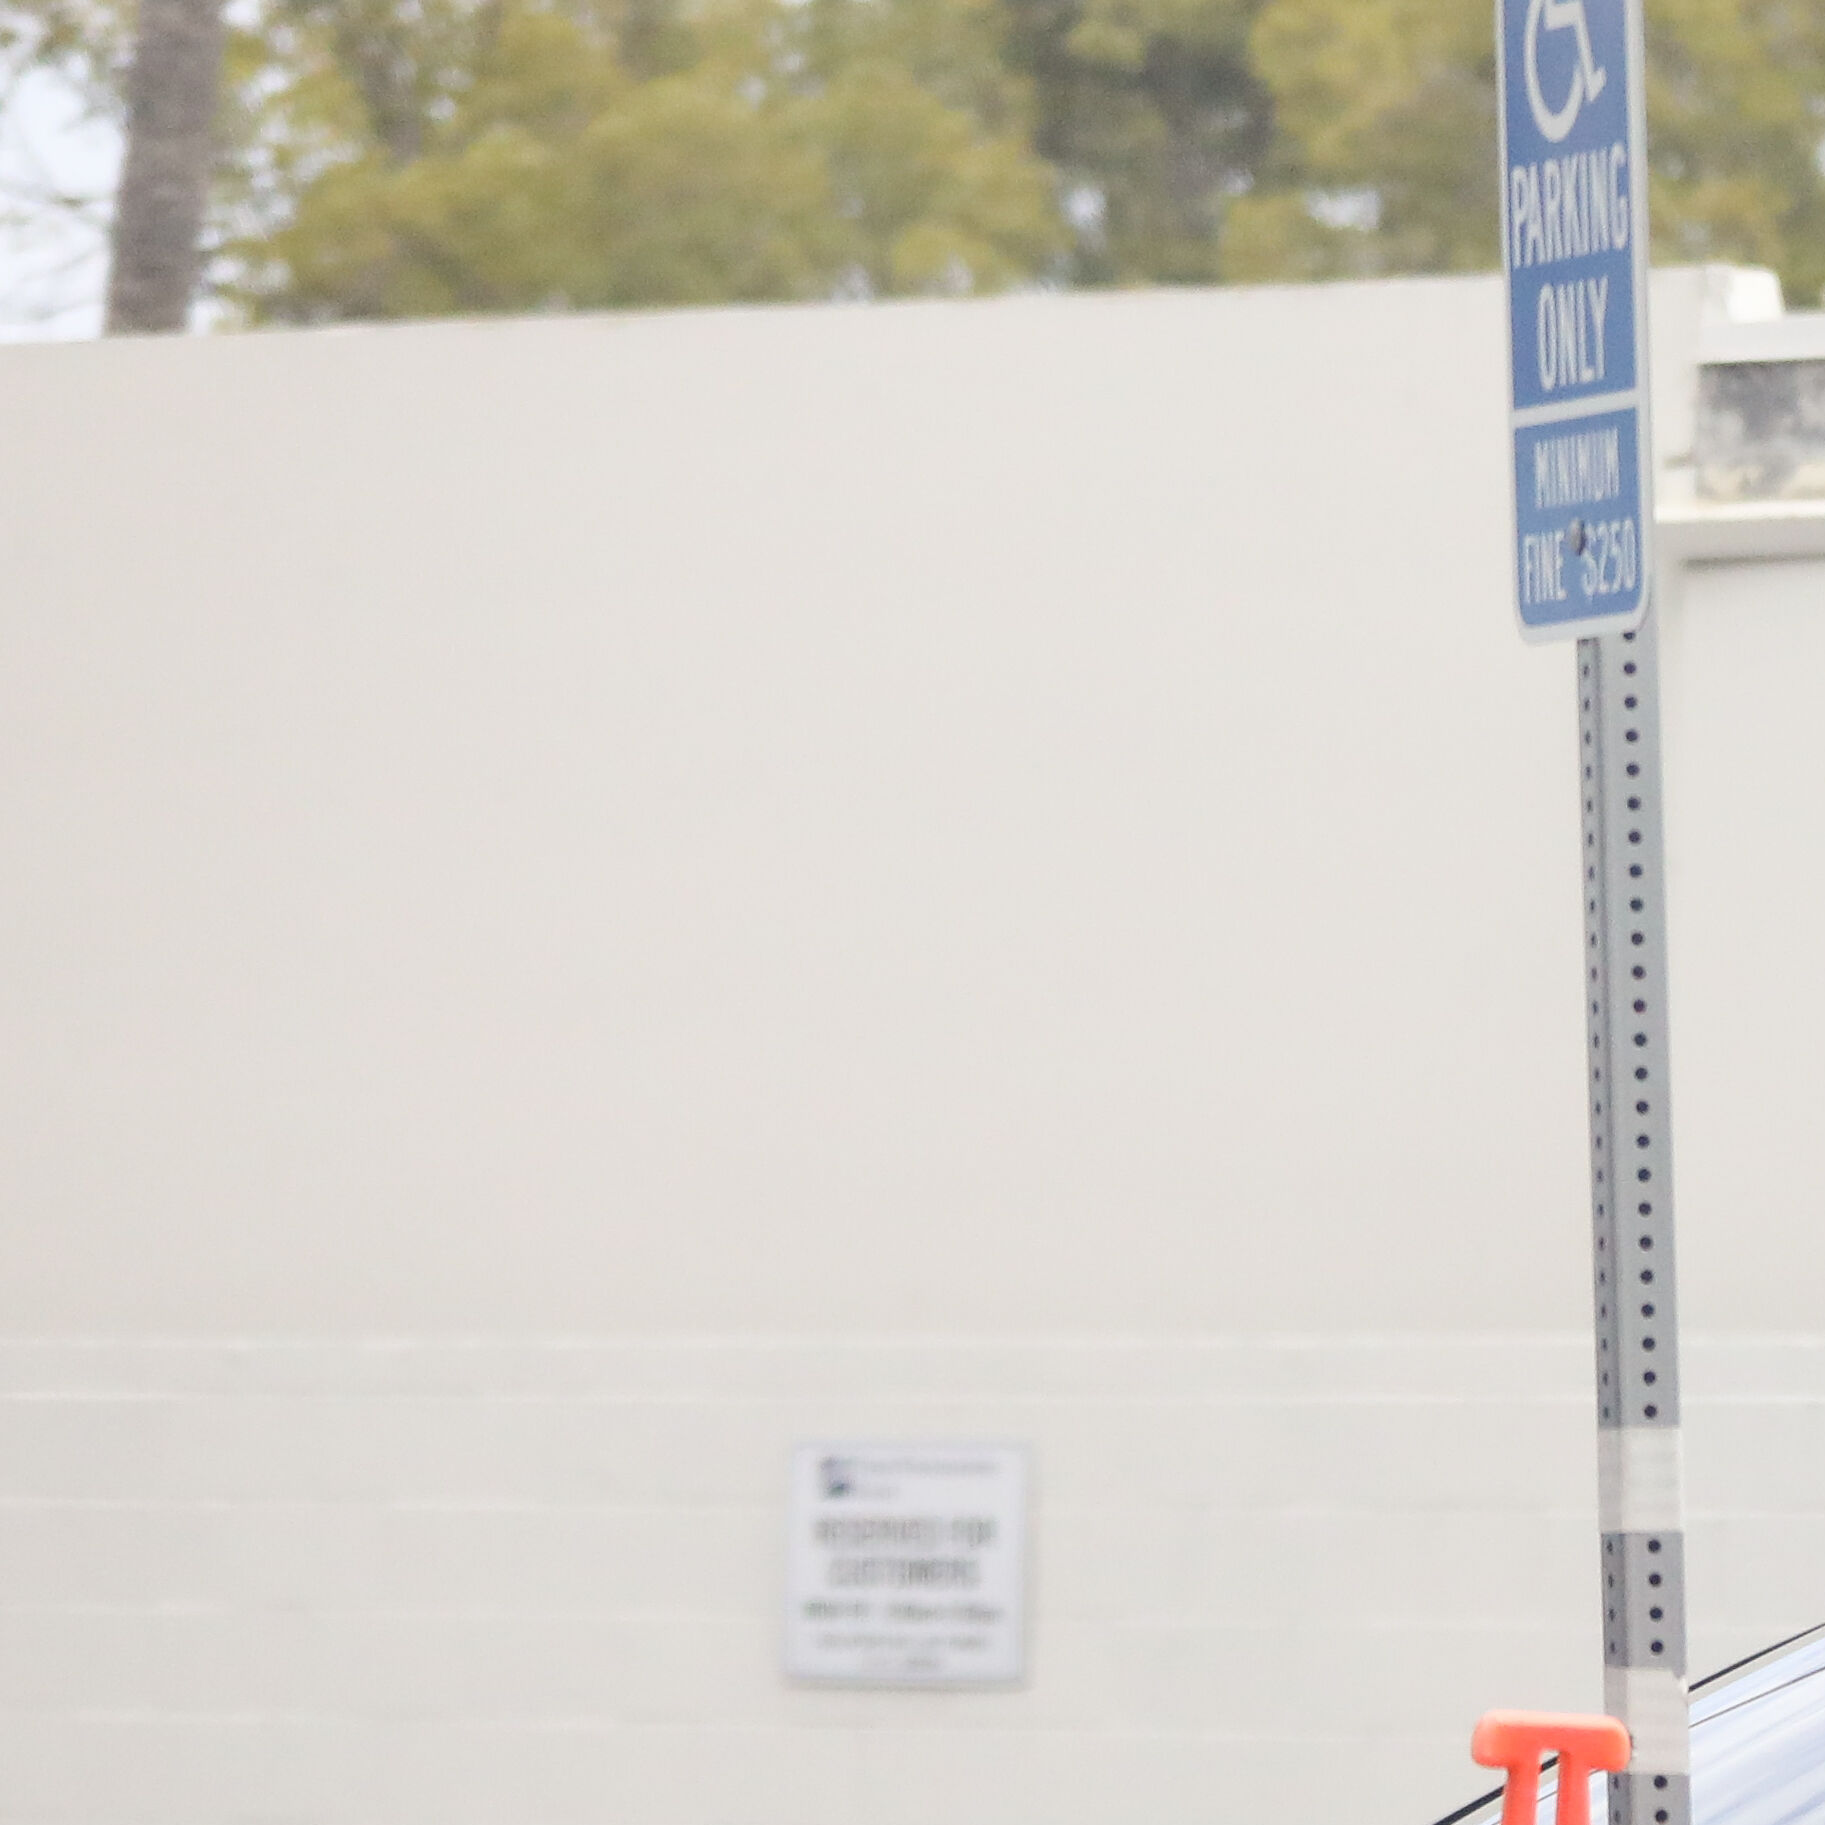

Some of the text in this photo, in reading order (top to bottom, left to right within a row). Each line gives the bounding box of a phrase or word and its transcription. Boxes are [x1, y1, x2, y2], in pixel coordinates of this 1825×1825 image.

[1510, 142, 1629, 269] PARKING
[1538, 275, 1609, 392] ONLY
[1534, 426, 1620, 509] MINIMUM
[1524, 517, 1637, 604] FINE $250
